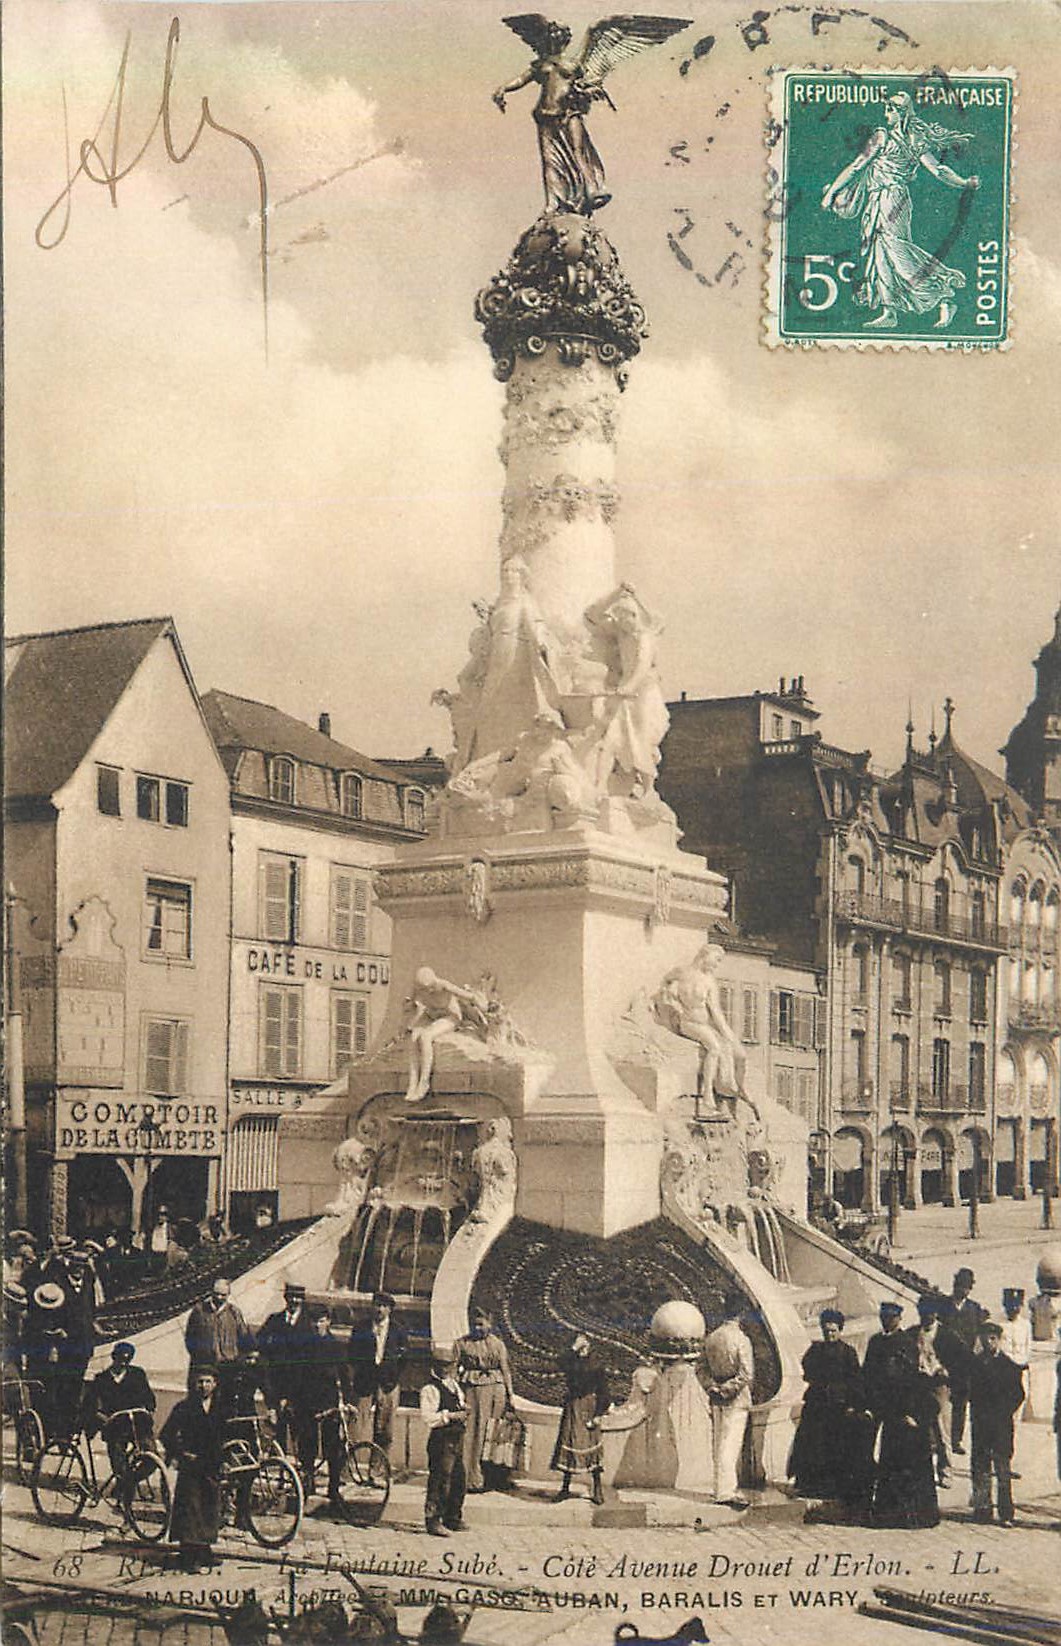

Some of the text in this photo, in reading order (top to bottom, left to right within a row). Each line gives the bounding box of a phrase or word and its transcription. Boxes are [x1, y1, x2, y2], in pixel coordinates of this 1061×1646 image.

[916, 87, 1003, 109] FRANÇAISE
[976, 240, 999, 326] POSTES
[305, 960, 322, 979] DE
[333, 964, 348, 981] LA
[233, 1089, 286, 1105] SALLE
[71, 1102, 218, 1125] COMPTOIR
[61, 1128, 88, 1148] DE
[93, 1129, 121, 1149] LA
